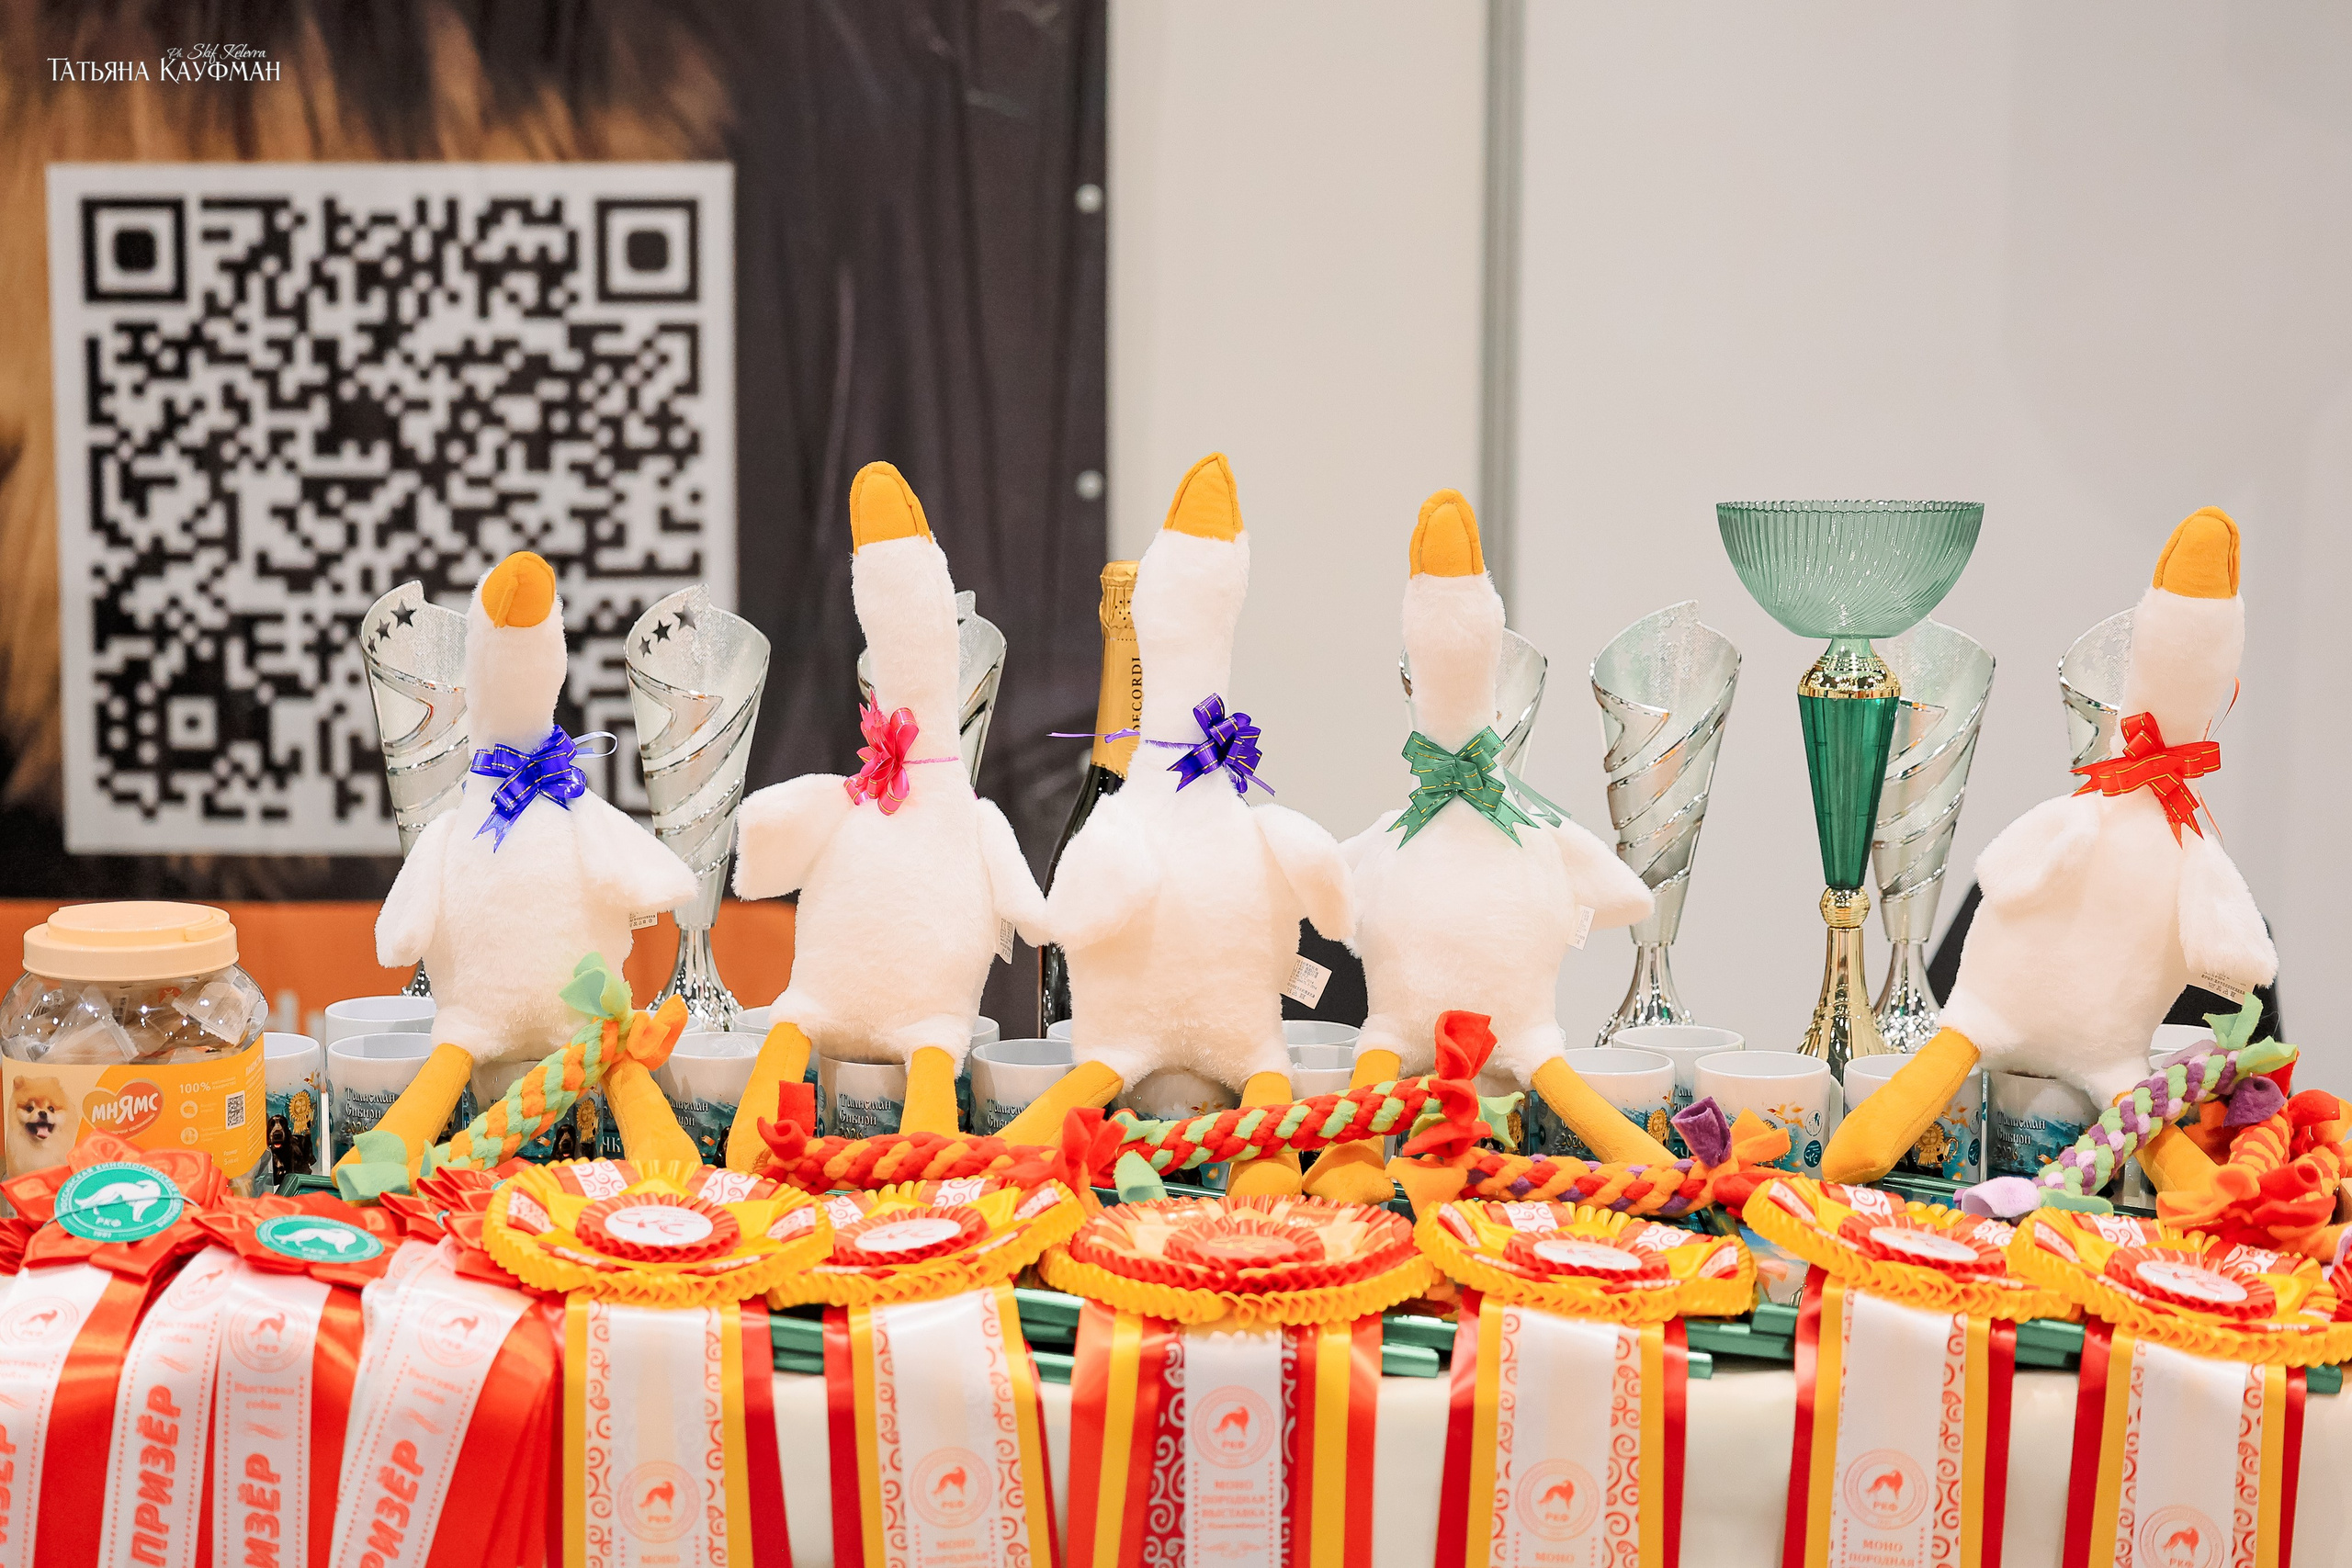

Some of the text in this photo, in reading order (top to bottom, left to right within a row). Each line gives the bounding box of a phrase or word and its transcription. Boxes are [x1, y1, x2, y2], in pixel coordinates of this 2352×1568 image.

[179, 1081, 211, 1094] 100%
[91, 1092, 159, 1125] МНЯМС
[664, 1093, 709, 1112] лисман
[986, 1099, 1027, 1117] Талисм
[677, 1115, 695, 1130] ири
[130, 1383, 182, 1568] ПРИЗЁР
[237, 1451, 282, 1568] ИЗЁР
[359, 1438, 425, 1568] РИЗЁР
